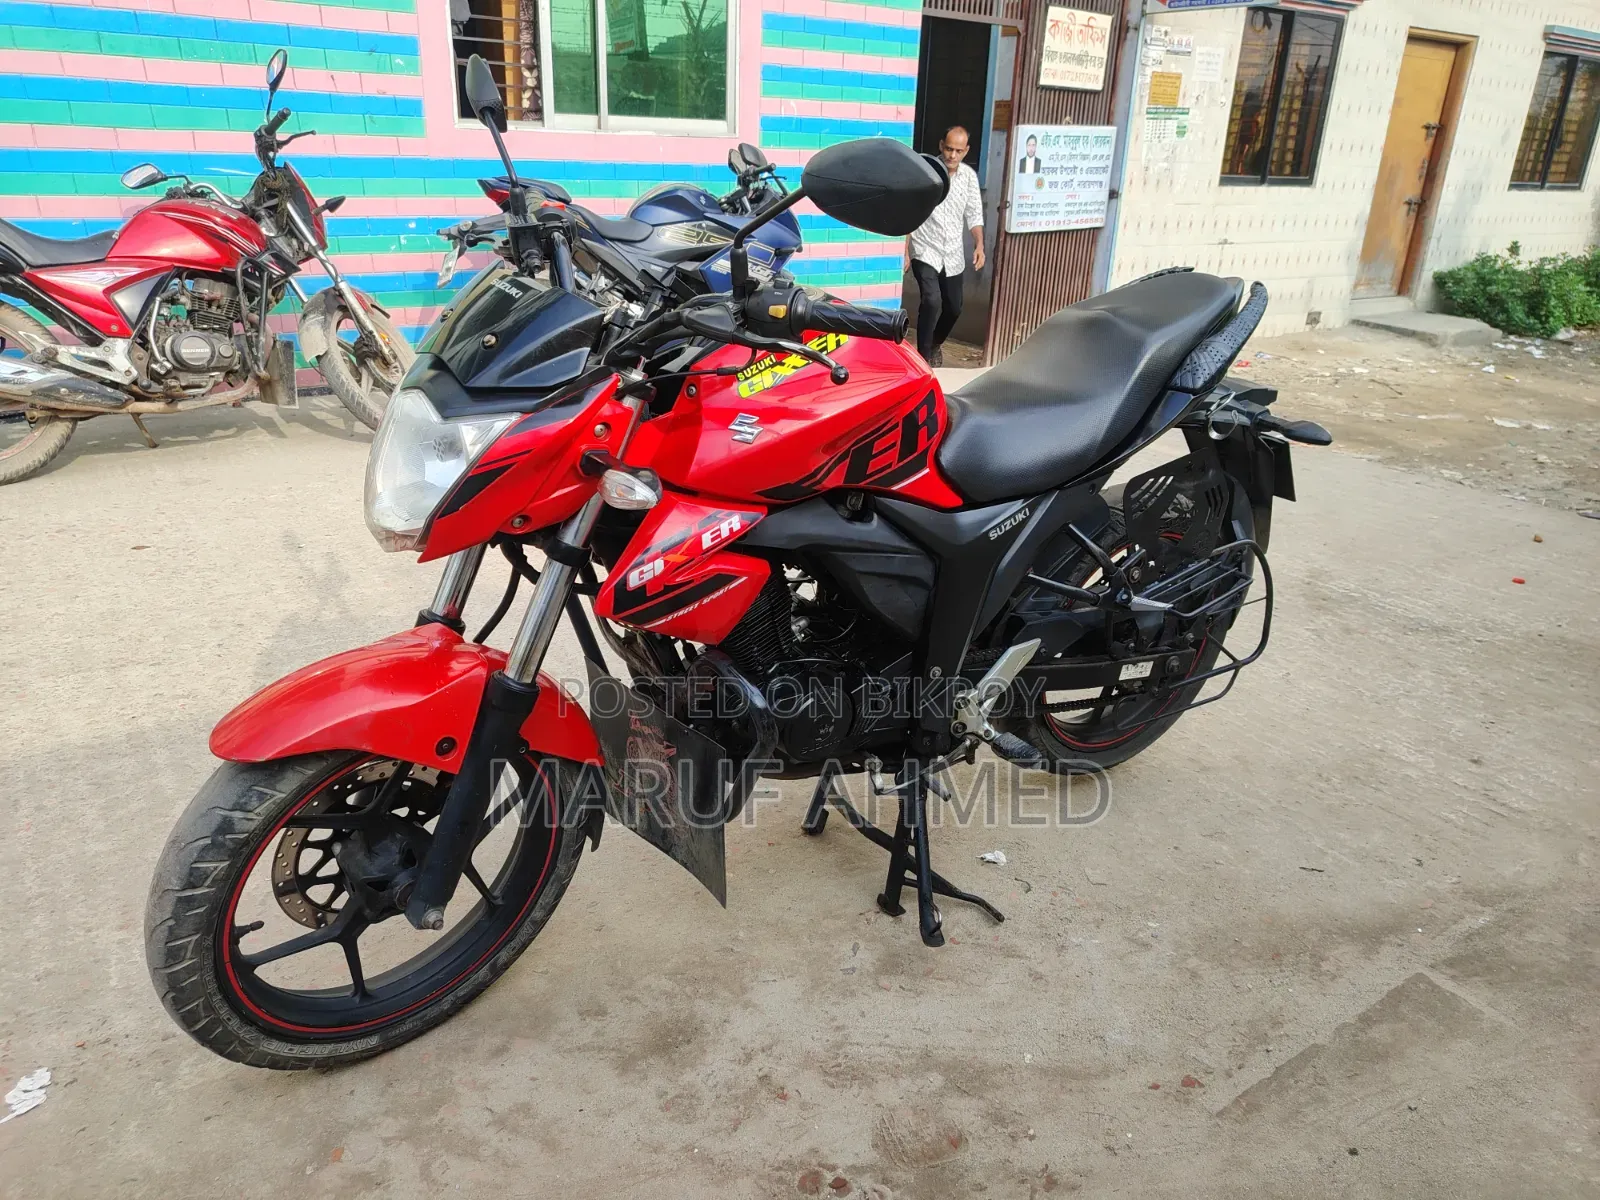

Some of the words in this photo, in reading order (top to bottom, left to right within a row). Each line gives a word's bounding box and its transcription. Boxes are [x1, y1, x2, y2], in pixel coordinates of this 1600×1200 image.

[1048, 12, 1076, 48] কাজী
[1077, 16, 1108, 50] অফিস
[490, 278, 523, 299] SUZUKI
[737, 354, 777, 382] SUZUKI
[988, 507, 1030, 541] SUZUKI
[666, 601, 701, 622] STREET
[702, 585, 729, 605] SPORT
